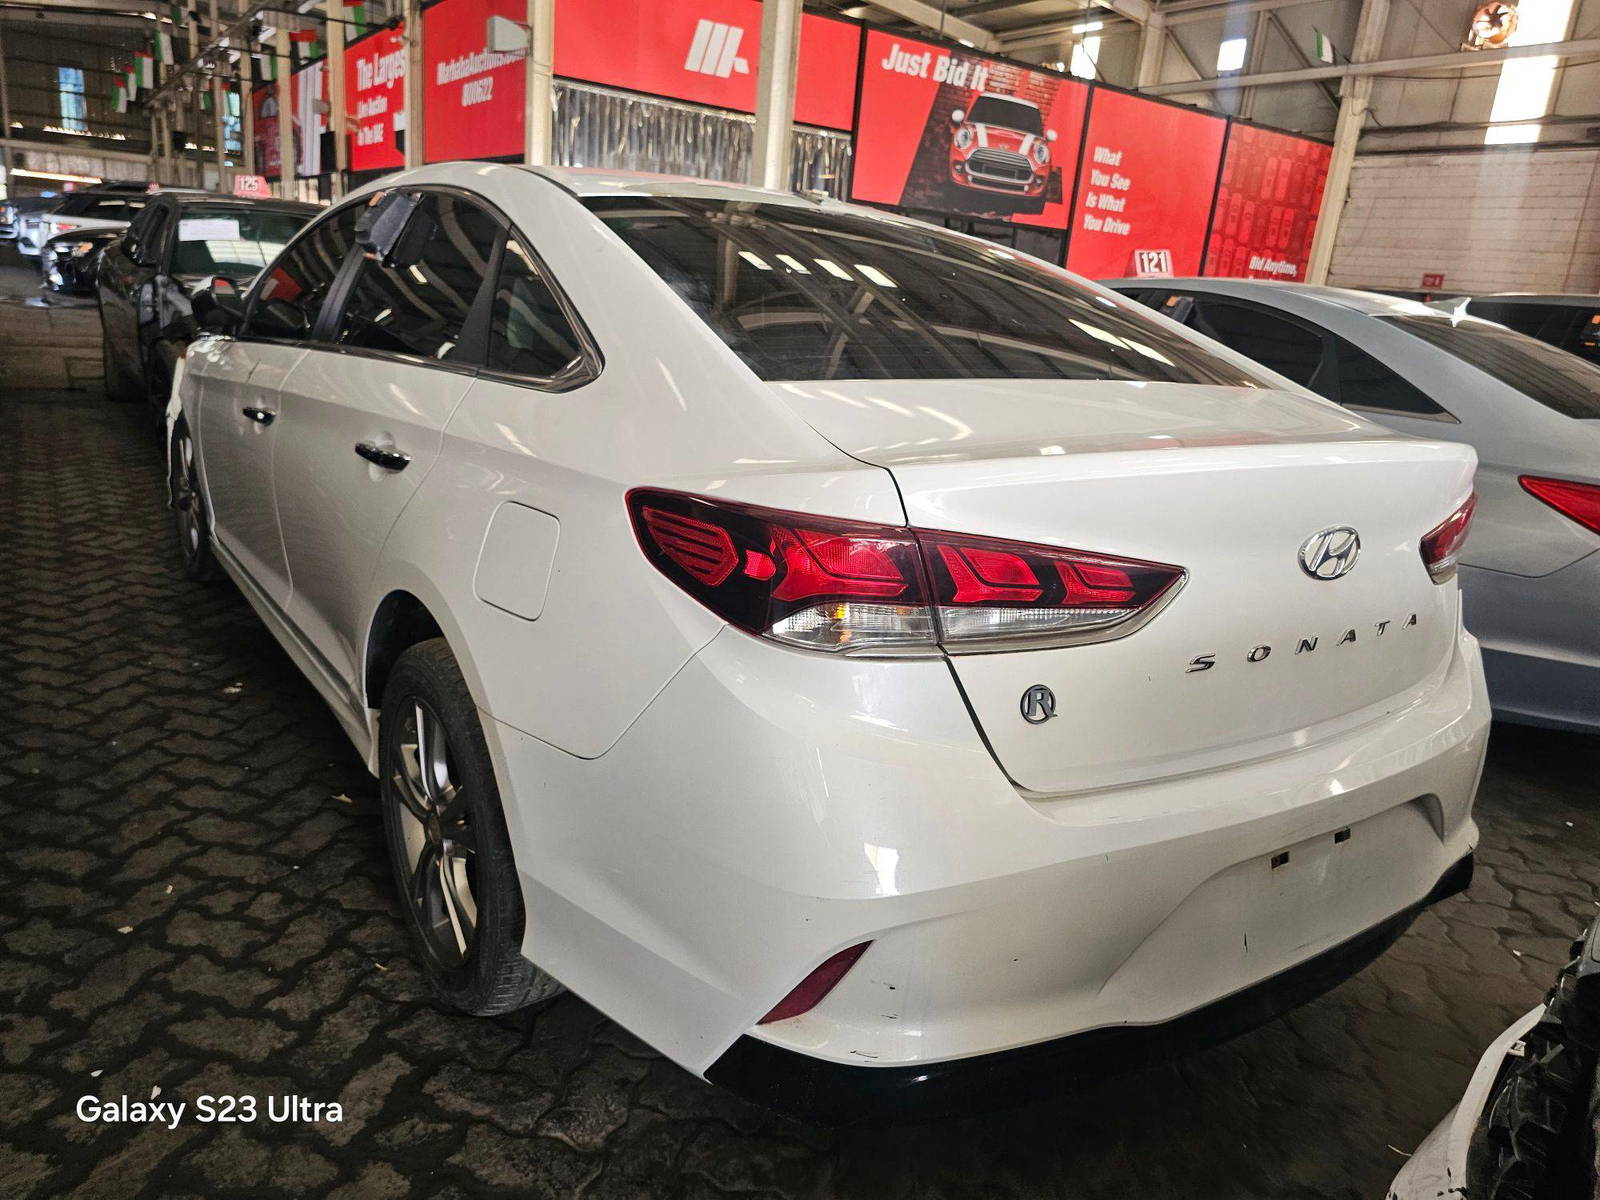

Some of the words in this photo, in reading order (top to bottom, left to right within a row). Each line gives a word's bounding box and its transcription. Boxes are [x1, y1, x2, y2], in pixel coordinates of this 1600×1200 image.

[356, 58, 373, 92] The
[881, 43, 932, 78] Just
[932, 55, 970, 87] Bid
[970, 64, 989, 92] It
[1093, 146, 1122, 167] What
[240, 177, 258, 191] 125
[1090, 168, 1111, 187] You
[1110, 172, 1132, 191] See
[1085, 191, 1098, 208] Is
[1098, 193, 1126, 212] What
[1083, 213, 1103, 232] You
[1102, 216, 1131, 236] Drive
[1141, 251, 1168, 273] 121
[1249, 255, 1267, 271] Bid
[1185, 612, 1420, 674] SONATA
